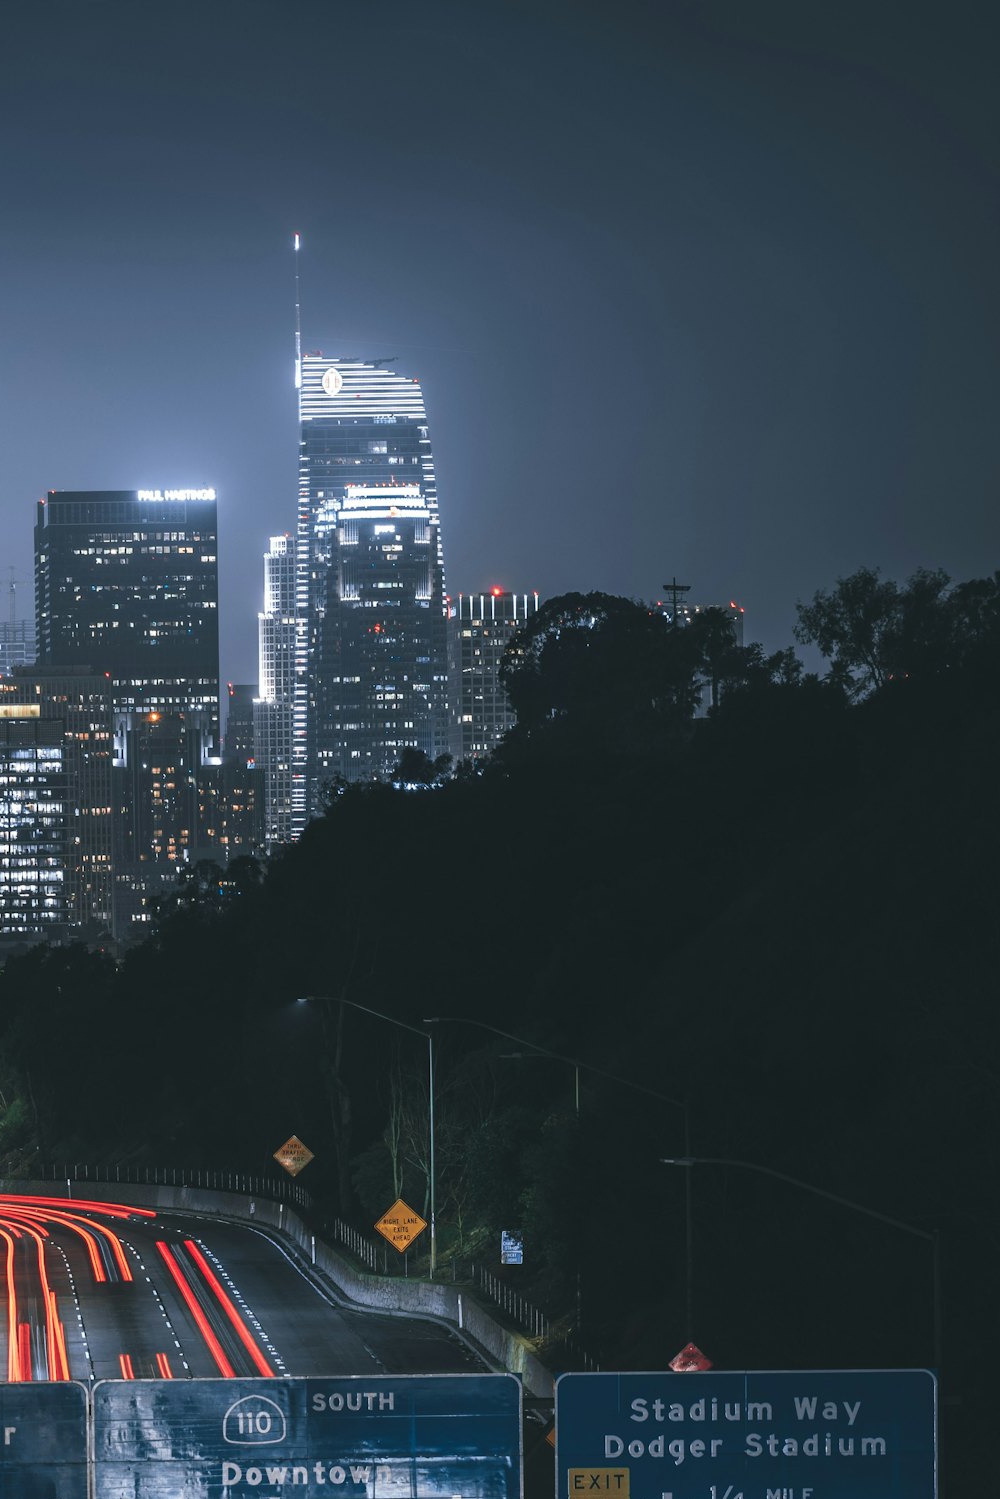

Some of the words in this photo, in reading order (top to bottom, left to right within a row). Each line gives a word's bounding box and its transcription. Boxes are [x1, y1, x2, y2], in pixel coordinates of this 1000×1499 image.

[137, 489, 164, 501] PAUL
[164, 488, 216, 500] HASTINGS
[403, 1217, 418, 1225] LANE
[312, 1392, 395, 1411] SOUTH
[629, 1397, 773, 1422] Stadium
[794, 1397, 861, 1425] Way
[237, 1411, 272, 1434] 110
[604, 1435, 723, 1466] Dodger
[744, 1433, 887, 1458] Stadium
[222, 1461, 393, 1486] Downtown
[573, 1474, 625, 1490] EXIT
